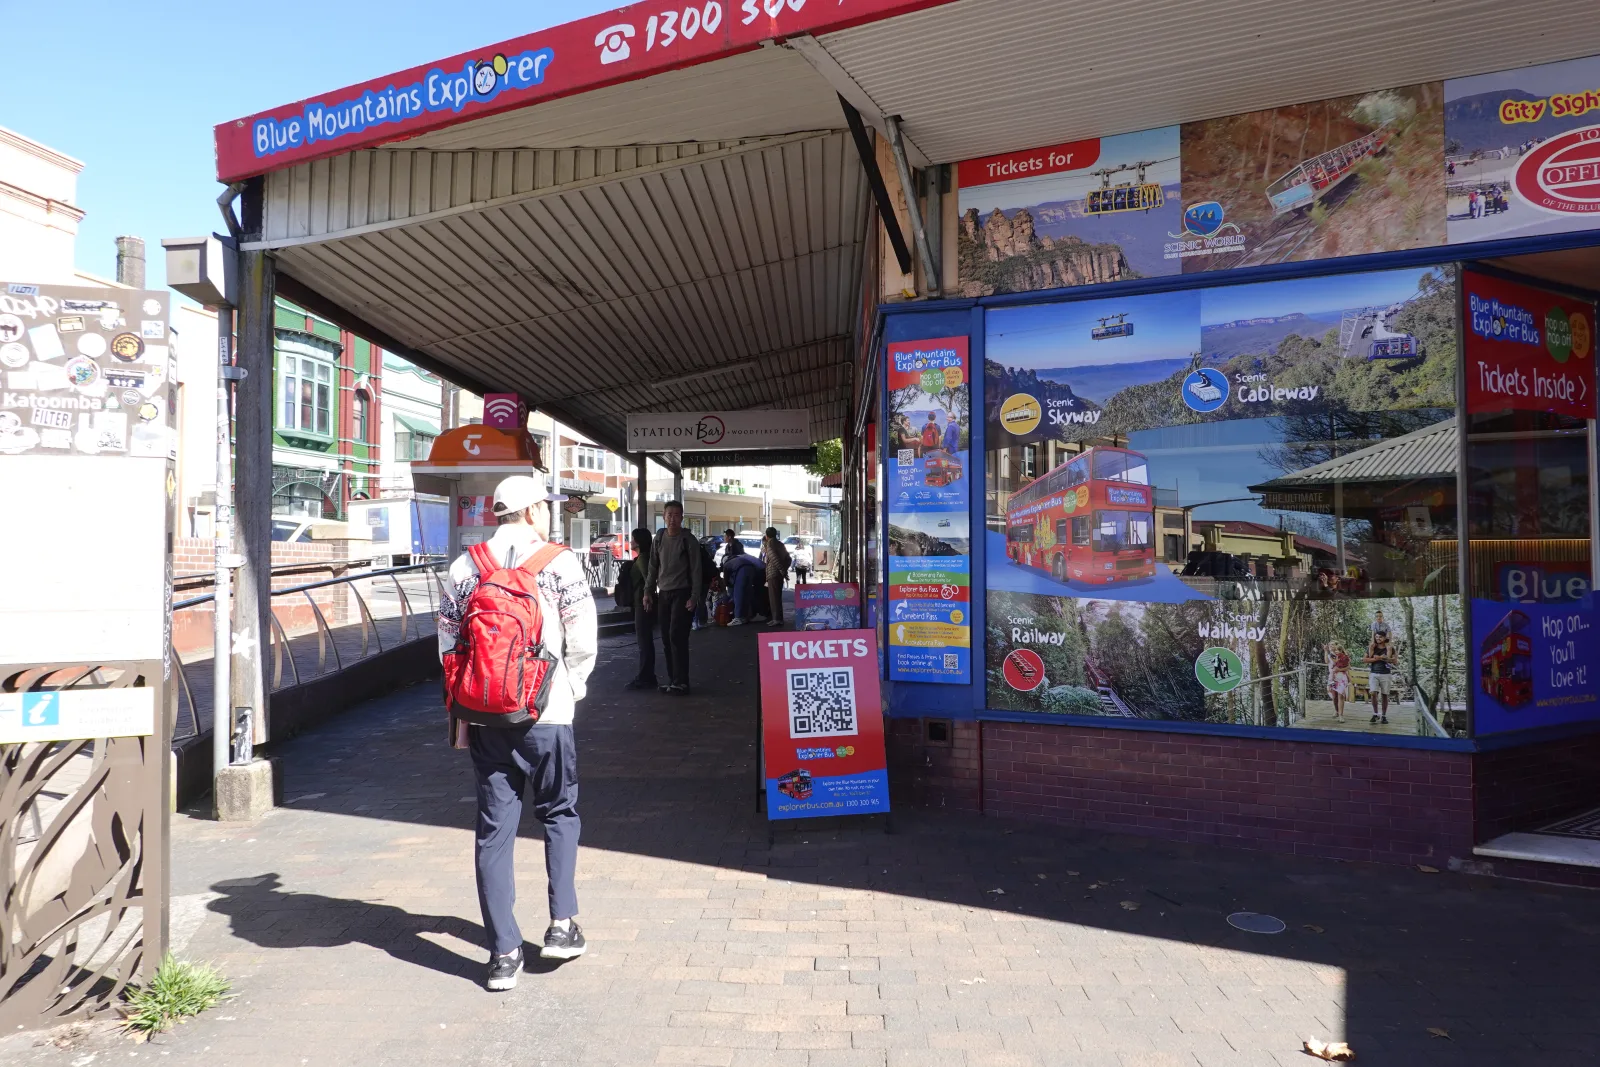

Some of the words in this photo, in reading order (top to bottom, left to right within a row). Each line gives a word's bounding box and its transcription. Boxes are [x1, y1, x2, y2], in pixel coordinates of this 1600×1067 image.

[645, 1, 722, 52] 1300
[257, 121, 300, 152] Blue
[308, 89, 422, 138] Mountains
[428, 53, 548, 107] Explorer
[1501, 101, 1545, 122] City
[1551, 91, 1600, 115] Sigh
[986, 157, 1043, 177] Tickets
[1047, 152, 1074, 168] for
[1541, 197, 1557, 207] OF
[1557, 202, 1576, 211] THE
[1163, 239, 1202, 254] SCENIC
[1203, 234, 1246, 249] WORLD
[1470, 295, 1490, 314] Blue
[1492, 301, 1533, 325] Mountains
[1473, 312, 1520, 339] Explorer
[1521, 325, 1539, 344] Bus
[1559, 319, 1569, 332] on
[1561, 333, 1572, 347] off
[895, 352, 912, 361] Blue
[915, 349, 956, 359] Mountains
[897, 358, 942, 371] Explorer
[943, 356, 962, 367] Bus
[920, 372, 932, 381] hop
[935, 377, 945, 386] off
[1235, 372, 1267, 384] Scenic
[1477, 361, 1529, 397] Tickets
[1533, 367, 1575, 402] Inside
[3, 392, 102, 410] Katoomba
[1237, 384, 1319, 403] Cableway
[1046, 398, 1074, 408] Scenic
[33, 409, 70, 427] FILTER
[1047, 409, 1101, 426] Skyway
[633, 427, 693, 437] STATION
[695, 421, 722, 441] Bar
[1051, 497, 1062, 507] Bus
[1136, 496, 1146, 504] Bus
[899, 585, 918, 593] Explorer
[918, 585, 928, 593] Bus
[928, 585, 938, 593] Pass
[1507, 569, 1587, 599] Blue
[901, 612, 925, 620] Lyrebird
[926, 612, 938, 620] Pass
[1007, 615, 1034, 626] Scenic
[1229, 611, 1260, 623] Scenic
[1198, 621, 1266, 642] Walkway
[1541, 615, 1564, 639] Hop
[1566, 613, 1591, 634] on...
[1011, 626, 1067, 647] Railway
[767, 638, 869, 661] TICKETS
[1550, 640, 1576, 665] You'll
[1550, 667, 1574, 688] Love
[1576, 664, 1587, 685] it!
[798, 751, 823, 760] Explorer
[778, 801, 845, 812] explorerbus.com.au
[859, 799, 870, 807] 300
